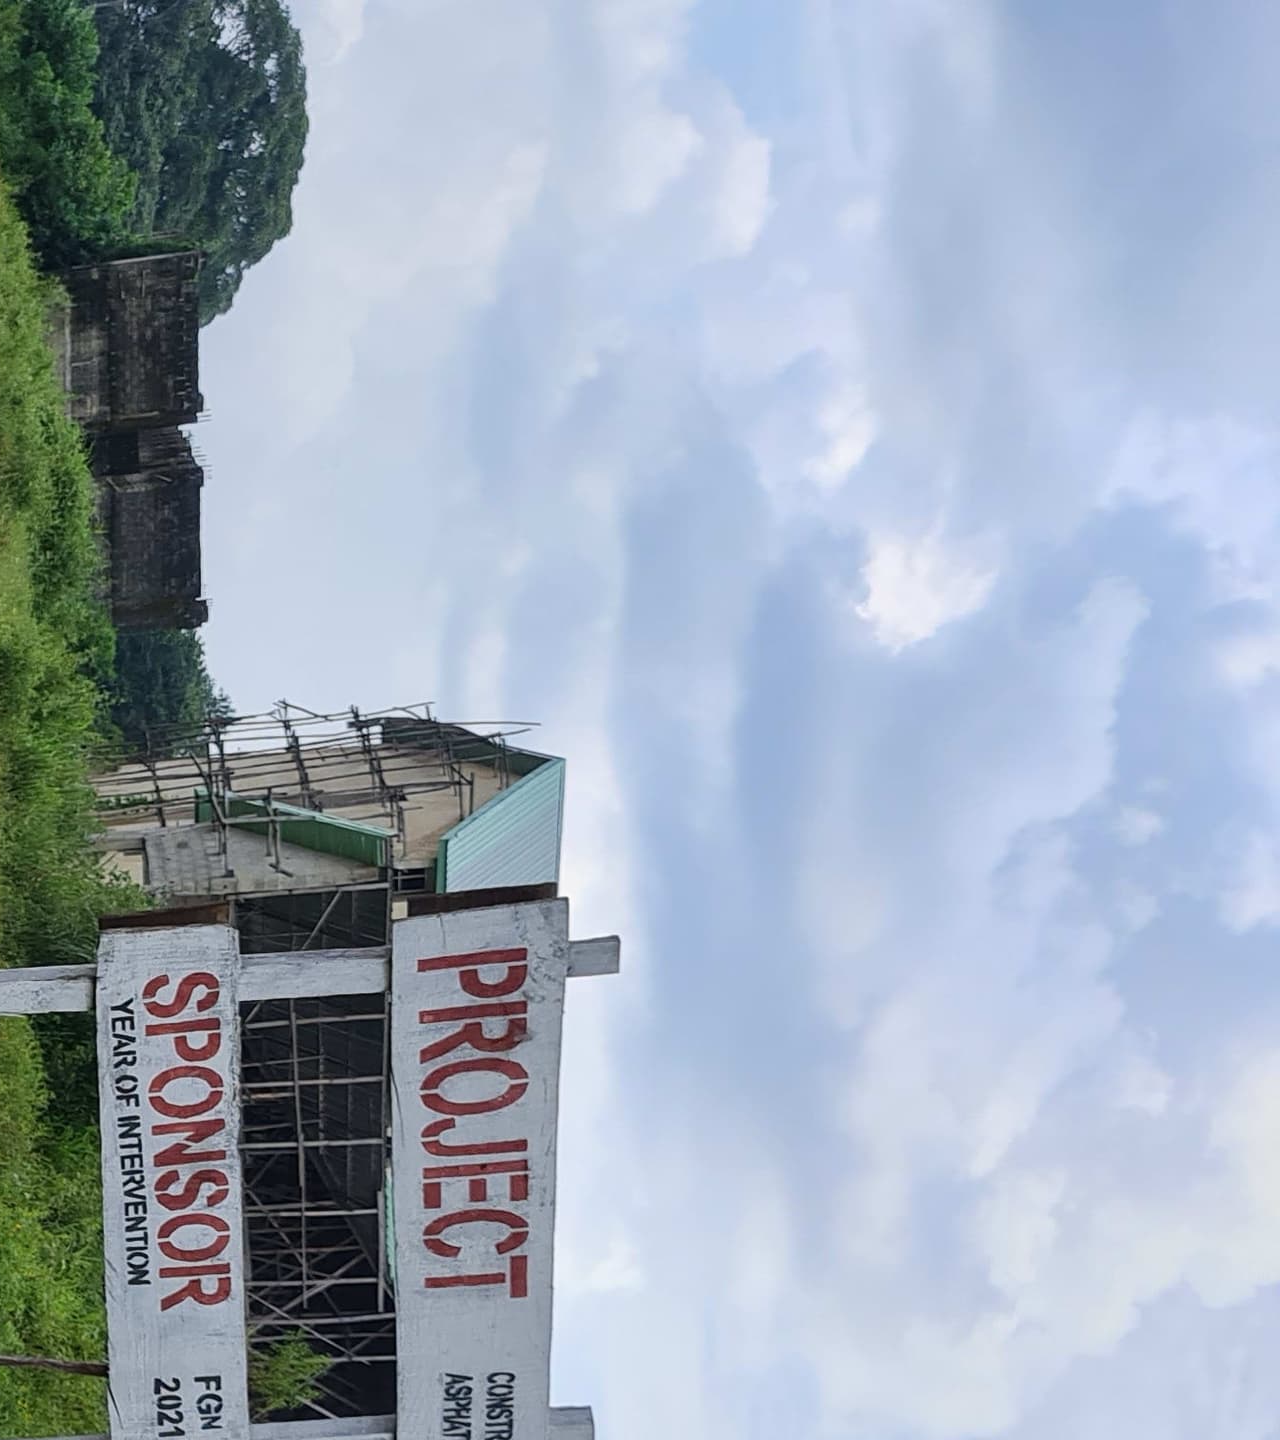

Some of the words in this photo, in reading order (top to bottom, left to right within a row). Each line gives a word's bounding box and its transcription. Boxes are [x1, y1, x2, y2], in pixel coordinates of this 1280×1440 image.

[110, 998, 137, 1068] YEAR
[114, 1074, 140, 1107] OF
[417, 947, 530, 1298] PROJECT
[142, 971, 232, 1312] SPONSOR
[117, 1116, 151, 1286] INTERVENTION
[154, 1377, 186, 1438] 2021
[193, 1374, 223, 1430] FGN
